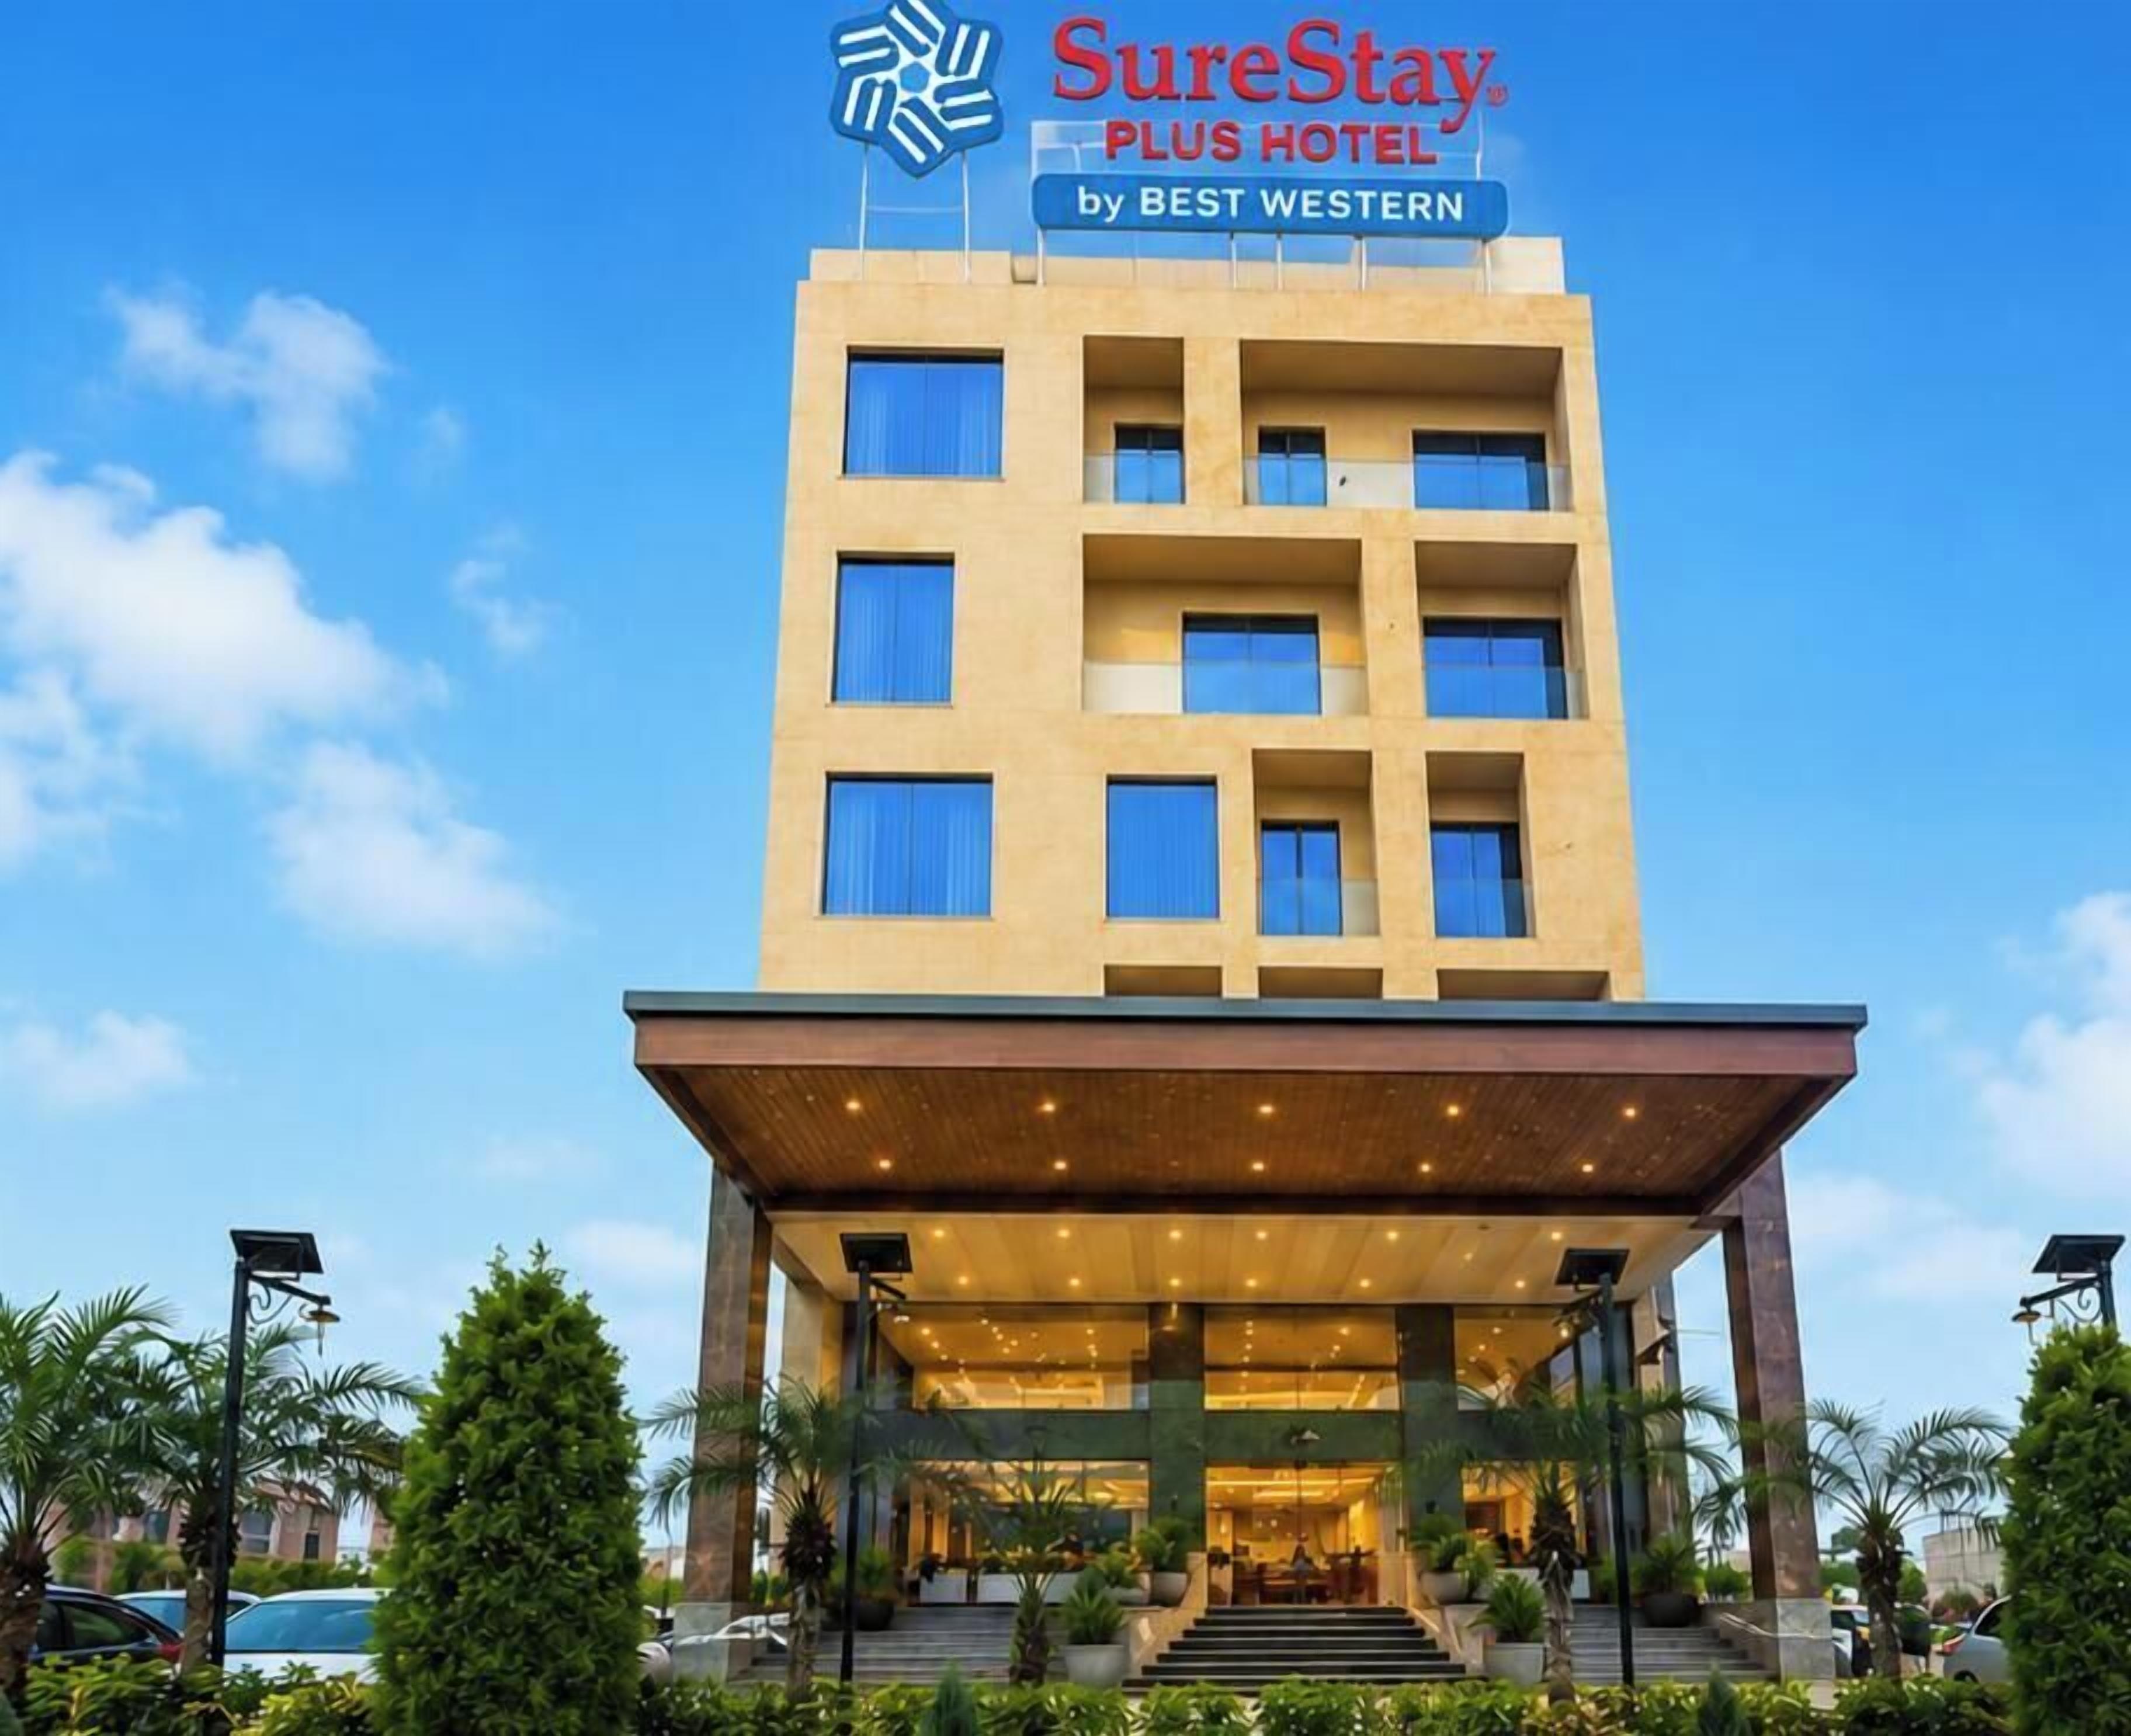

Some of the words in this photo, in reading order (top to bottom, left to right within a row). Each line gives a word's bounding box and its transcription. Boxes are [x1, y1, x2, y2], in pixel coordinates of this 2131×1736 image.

[1105, 120, 1241, 162] PLUS
[1260, 122, 1438, 165] HOTEL
[1078, 186, 1125, 223] by
[1140, 188, 1245, 217] BEST
[1259, 189, 1464, 221] WESTERN
